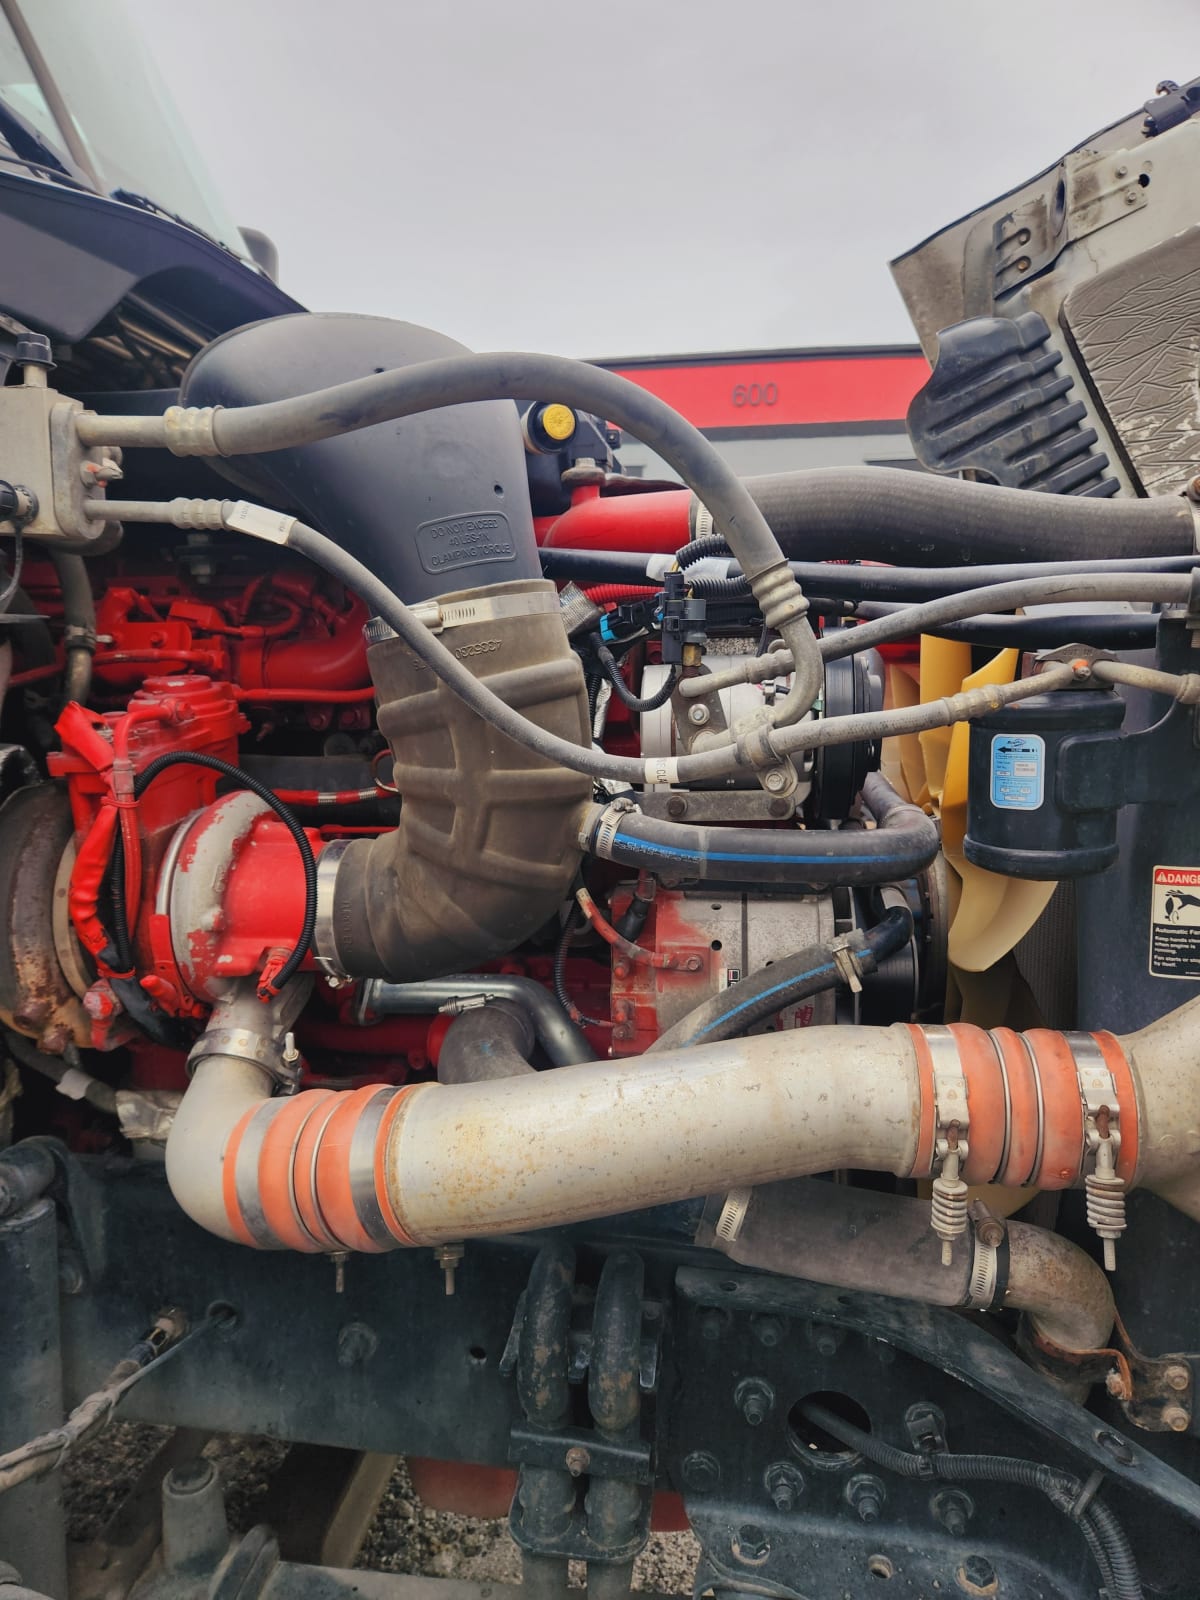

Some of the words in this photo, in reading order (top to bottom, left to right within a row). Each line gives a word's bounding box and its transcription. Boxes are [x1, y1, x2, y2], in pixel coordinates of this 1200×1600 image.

[732, 381, 779, 408] 600
[431, 527, 445, 538] DO
[447, 522, 464, 536] NOT
[467, 518, 498, 531] EXCEED
[431, 547, 477, 566] CLAMPING
[477, 542, 512, 557] TORQUE
